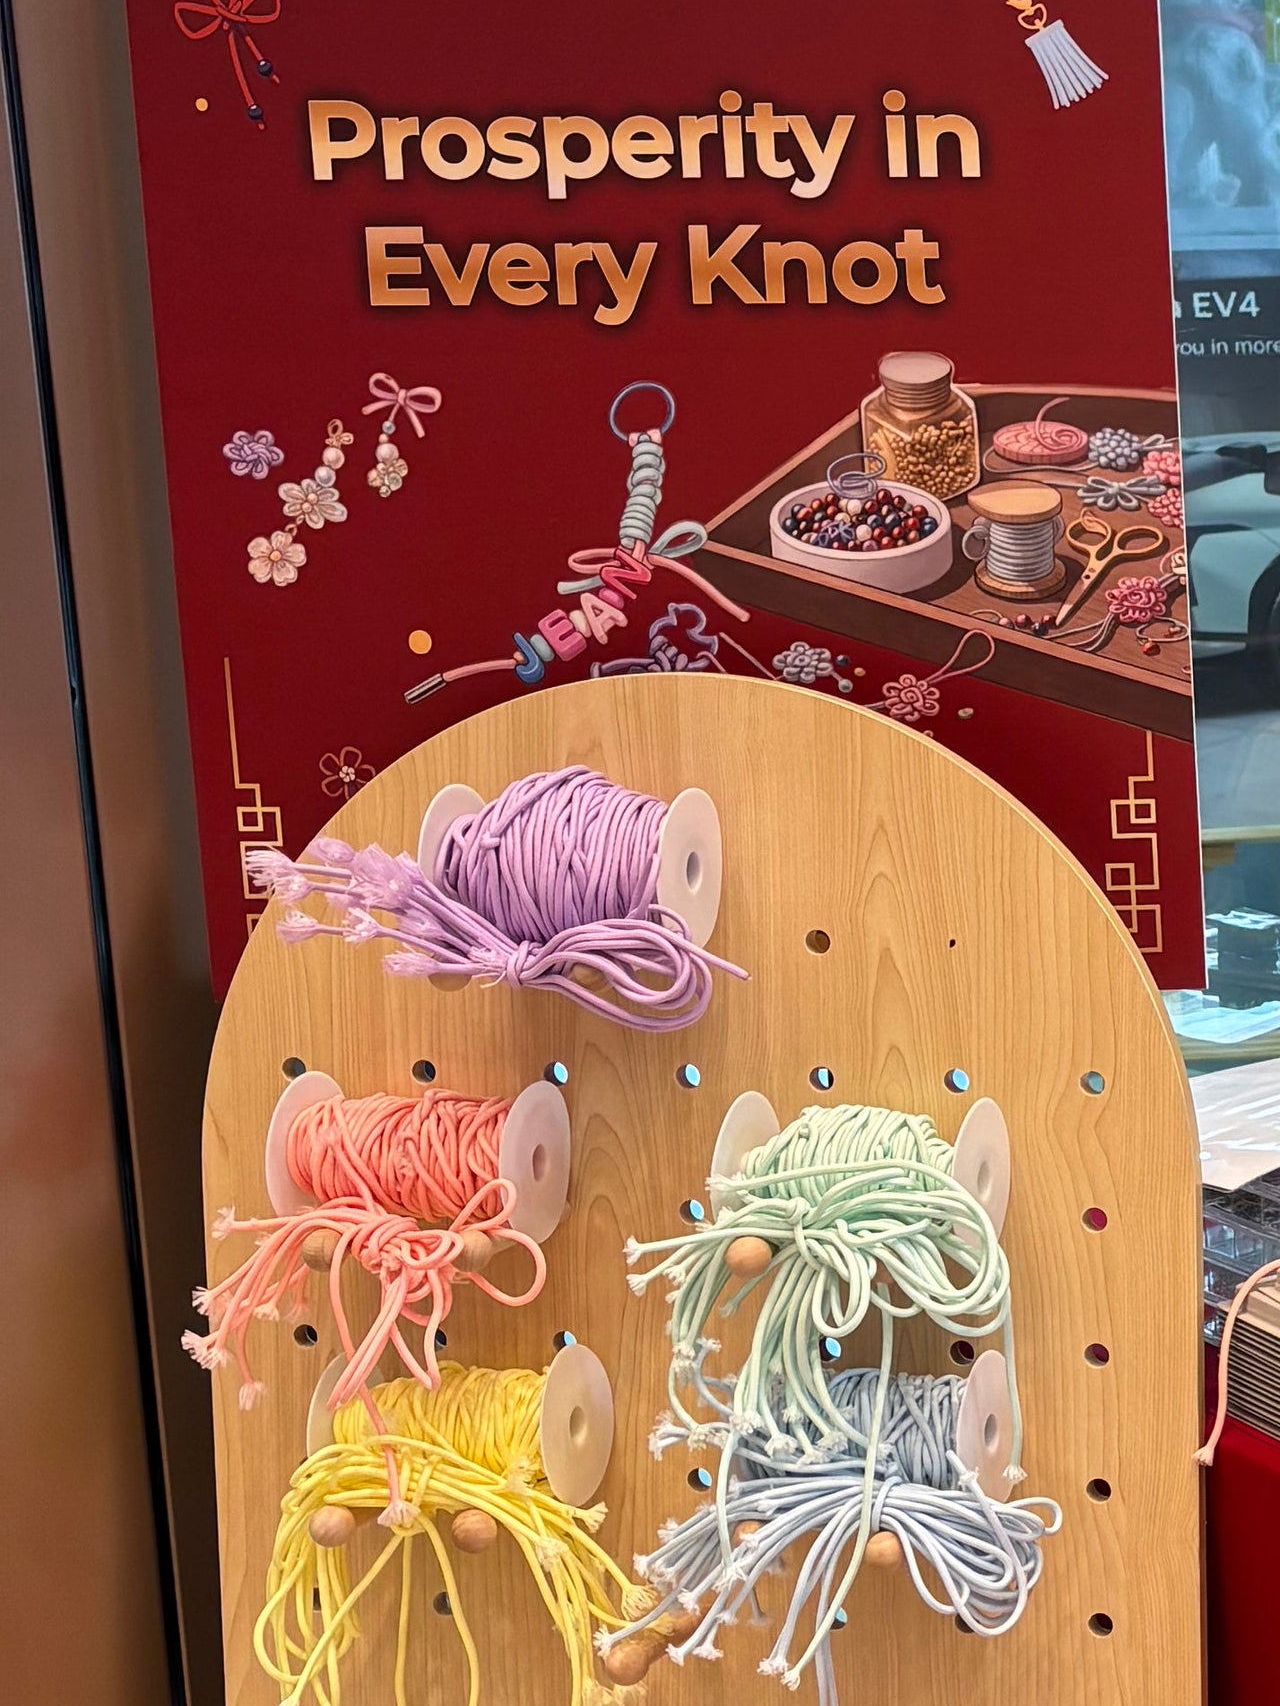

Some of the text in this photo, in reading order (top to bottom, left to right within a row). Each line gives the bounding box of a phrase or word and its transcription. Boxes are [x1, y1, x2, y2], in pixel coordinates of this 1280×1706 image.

[307, 90, 981, 200] Prosperity in
[365, 224, 946, 326] Every Knot
[1193, 291, 1260, 318] EV4
[1211, 339, 1229, 355] in
